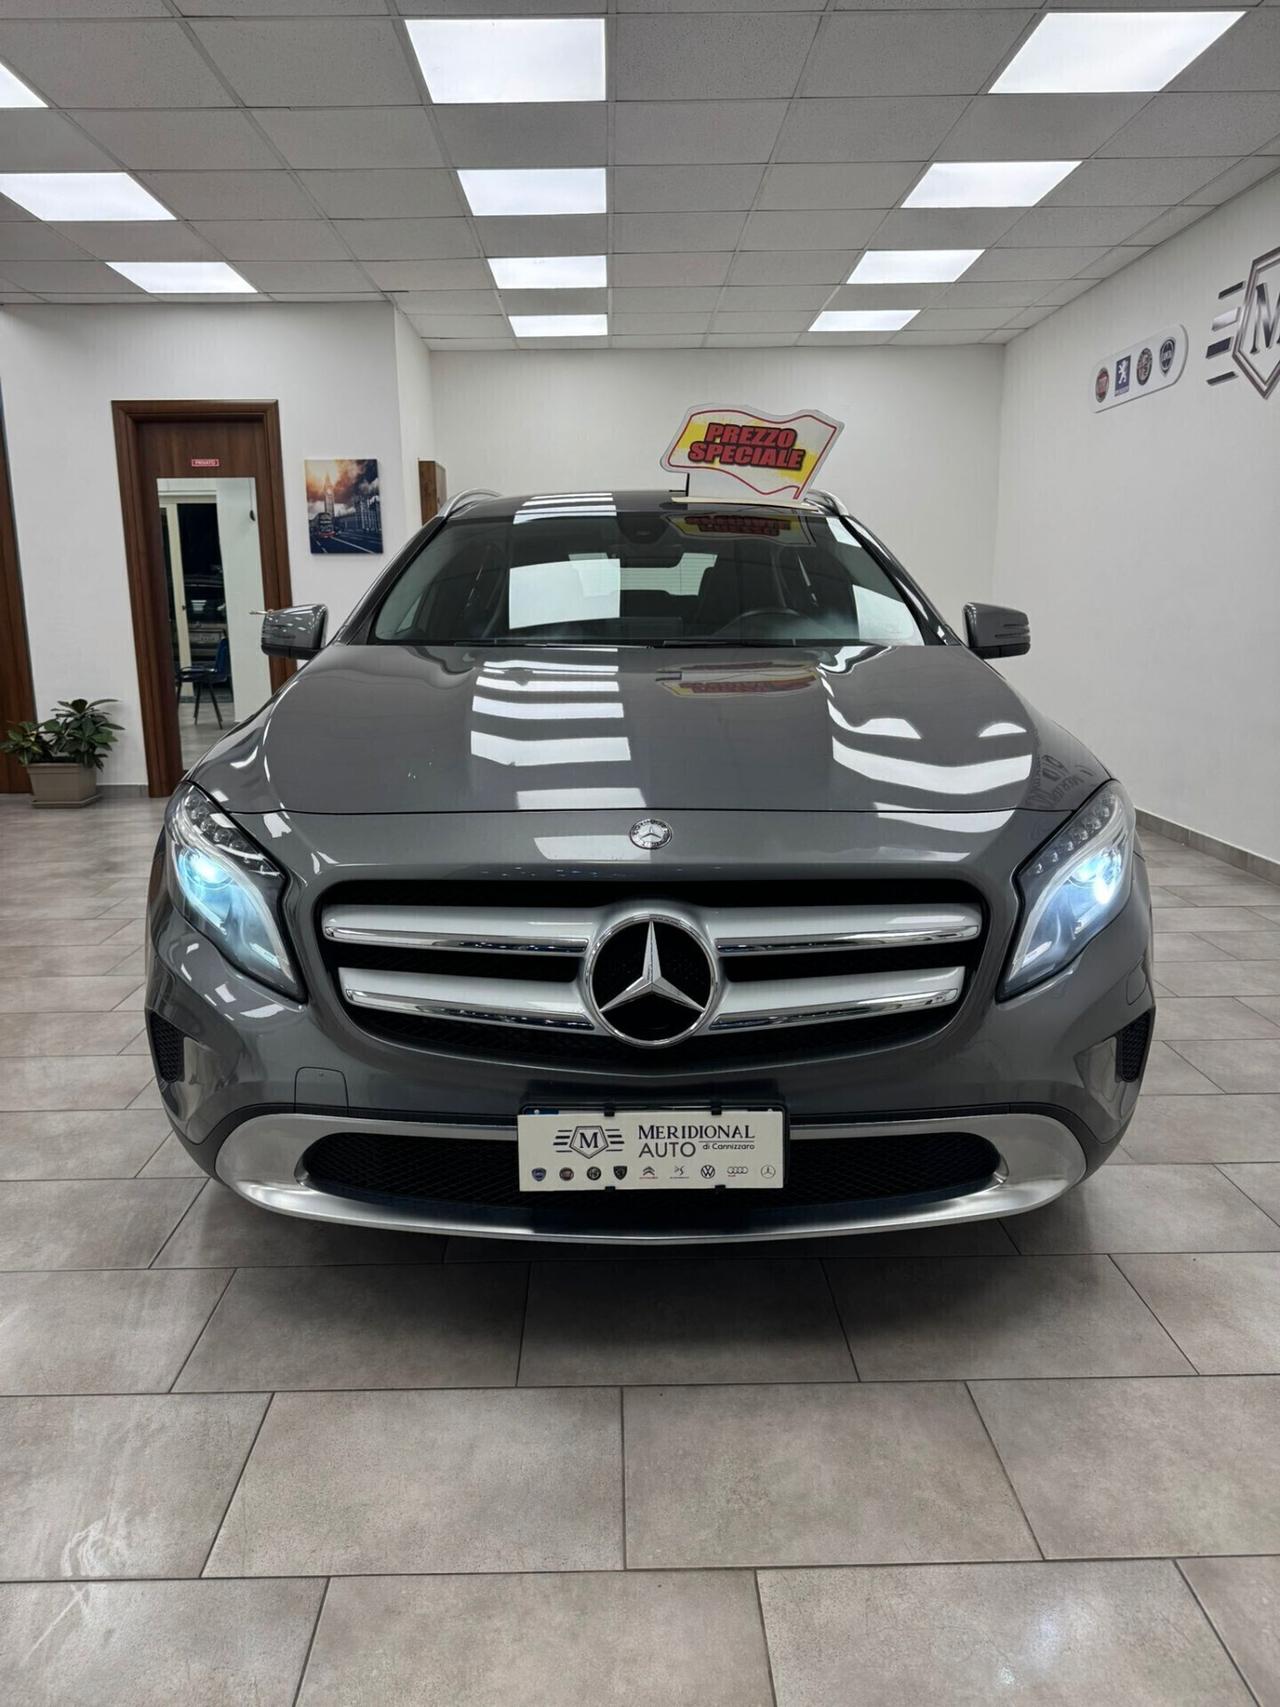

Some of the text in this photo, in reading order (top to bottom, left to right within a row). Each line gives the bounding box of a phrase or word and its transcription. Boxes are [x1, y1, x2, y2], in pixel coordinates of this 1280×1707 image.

[704, 422, 798, 449] PREZZO
[688, 440, 806, 471] SPECIALE
[579, 1132, 599, 1149] M
[638, 1124, 756, 1140] MERIDIONAL
[638, 1141, 696, 1158] AUTO
